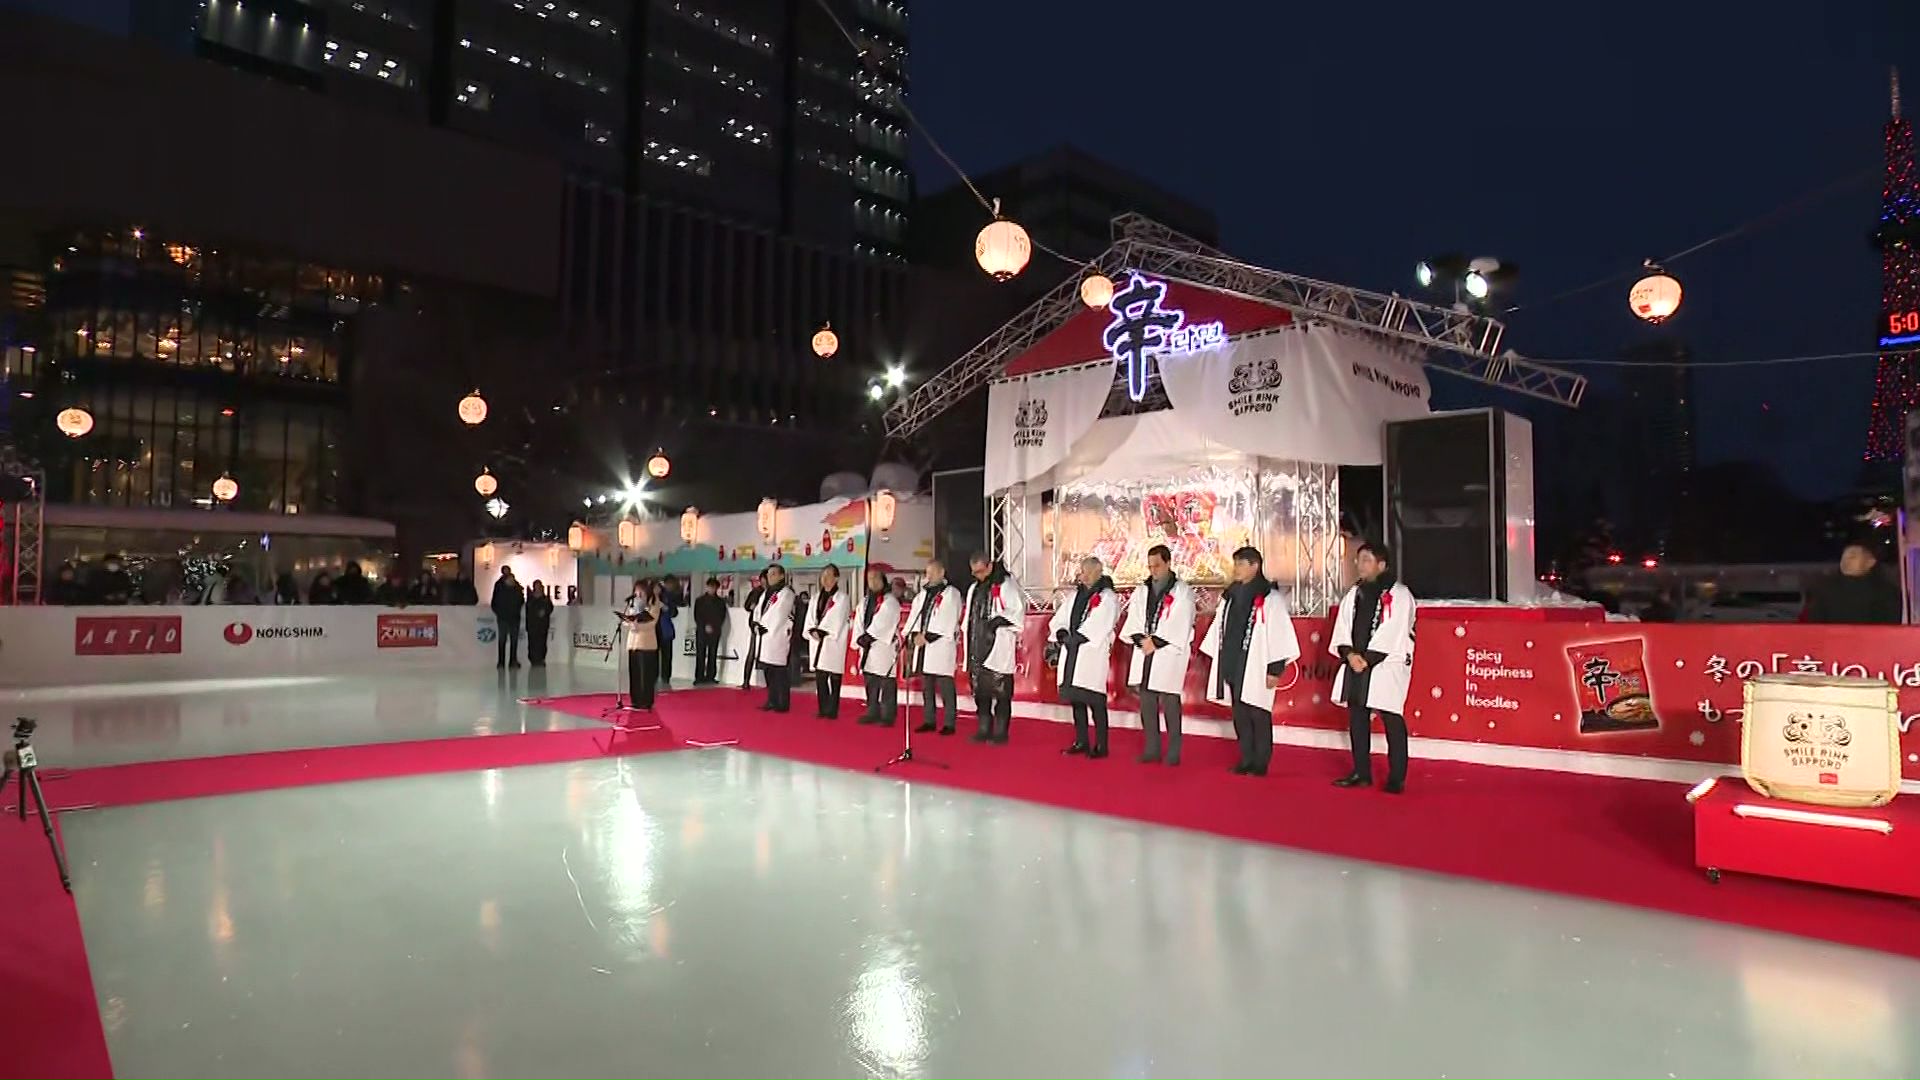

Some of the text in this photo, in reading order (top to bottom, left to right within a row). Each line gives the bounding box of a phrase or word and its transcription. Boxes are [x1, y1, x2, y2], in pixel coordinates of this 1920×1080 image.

[256, 626, 324, 638] NONGSHIM
[1466, 648, 1502, 664] Spicy
[1465, 663, 1534, 680] Happiness
[1465, 679, 1478, 692] In
[1465, 694, 1519, 710] Noodles
[1784, 747, 1815, 758] SMILE
[1791, 757, 1842, 770] SAPPORO
